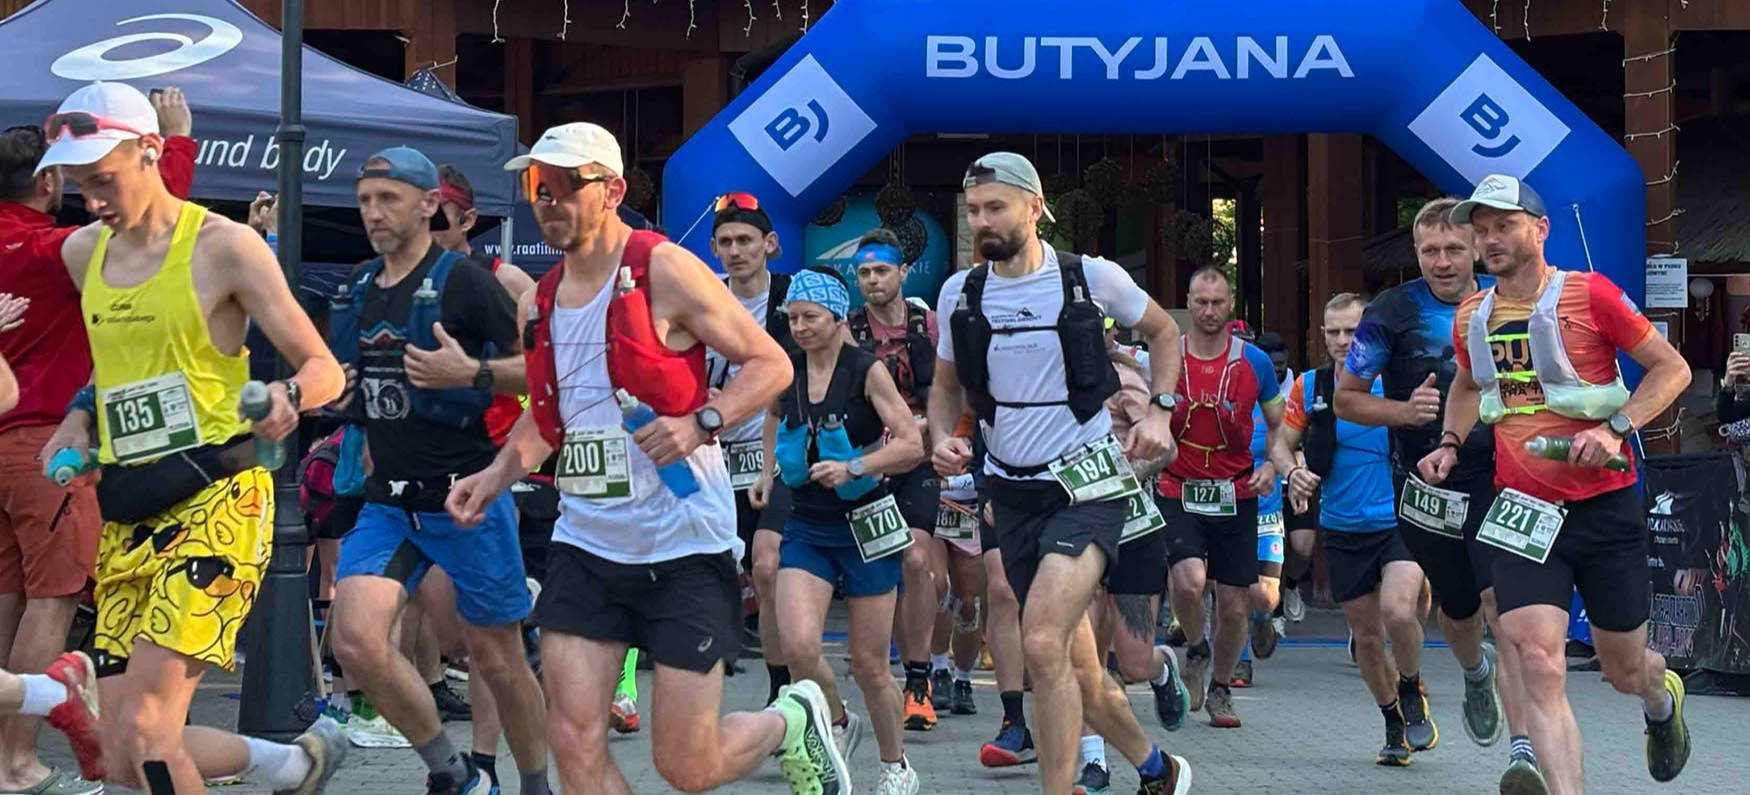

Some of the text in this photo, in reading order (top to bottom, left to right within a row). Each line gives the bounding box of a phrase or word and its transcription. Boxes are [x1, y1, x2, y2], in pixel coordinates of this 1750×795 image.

[926, 35, 1356, 80] BUTYJANA
[764, 98, 829, 152] BJ
[1459, 92, 1521, 158] BJ
[260, 136, 347, 180] bdy
[115, 396, 155, 434] 135
[563, 442, 600, 475] 200
[738, 450, 764, 473] 209
[1072, 451, 1111, 484] 194
[1192, 486, 1217, 503] 127
[1414, 489, 1441, 516] 149
[864, 508, 898, 538] 170
[1496, 500, 1533, 532] 221
